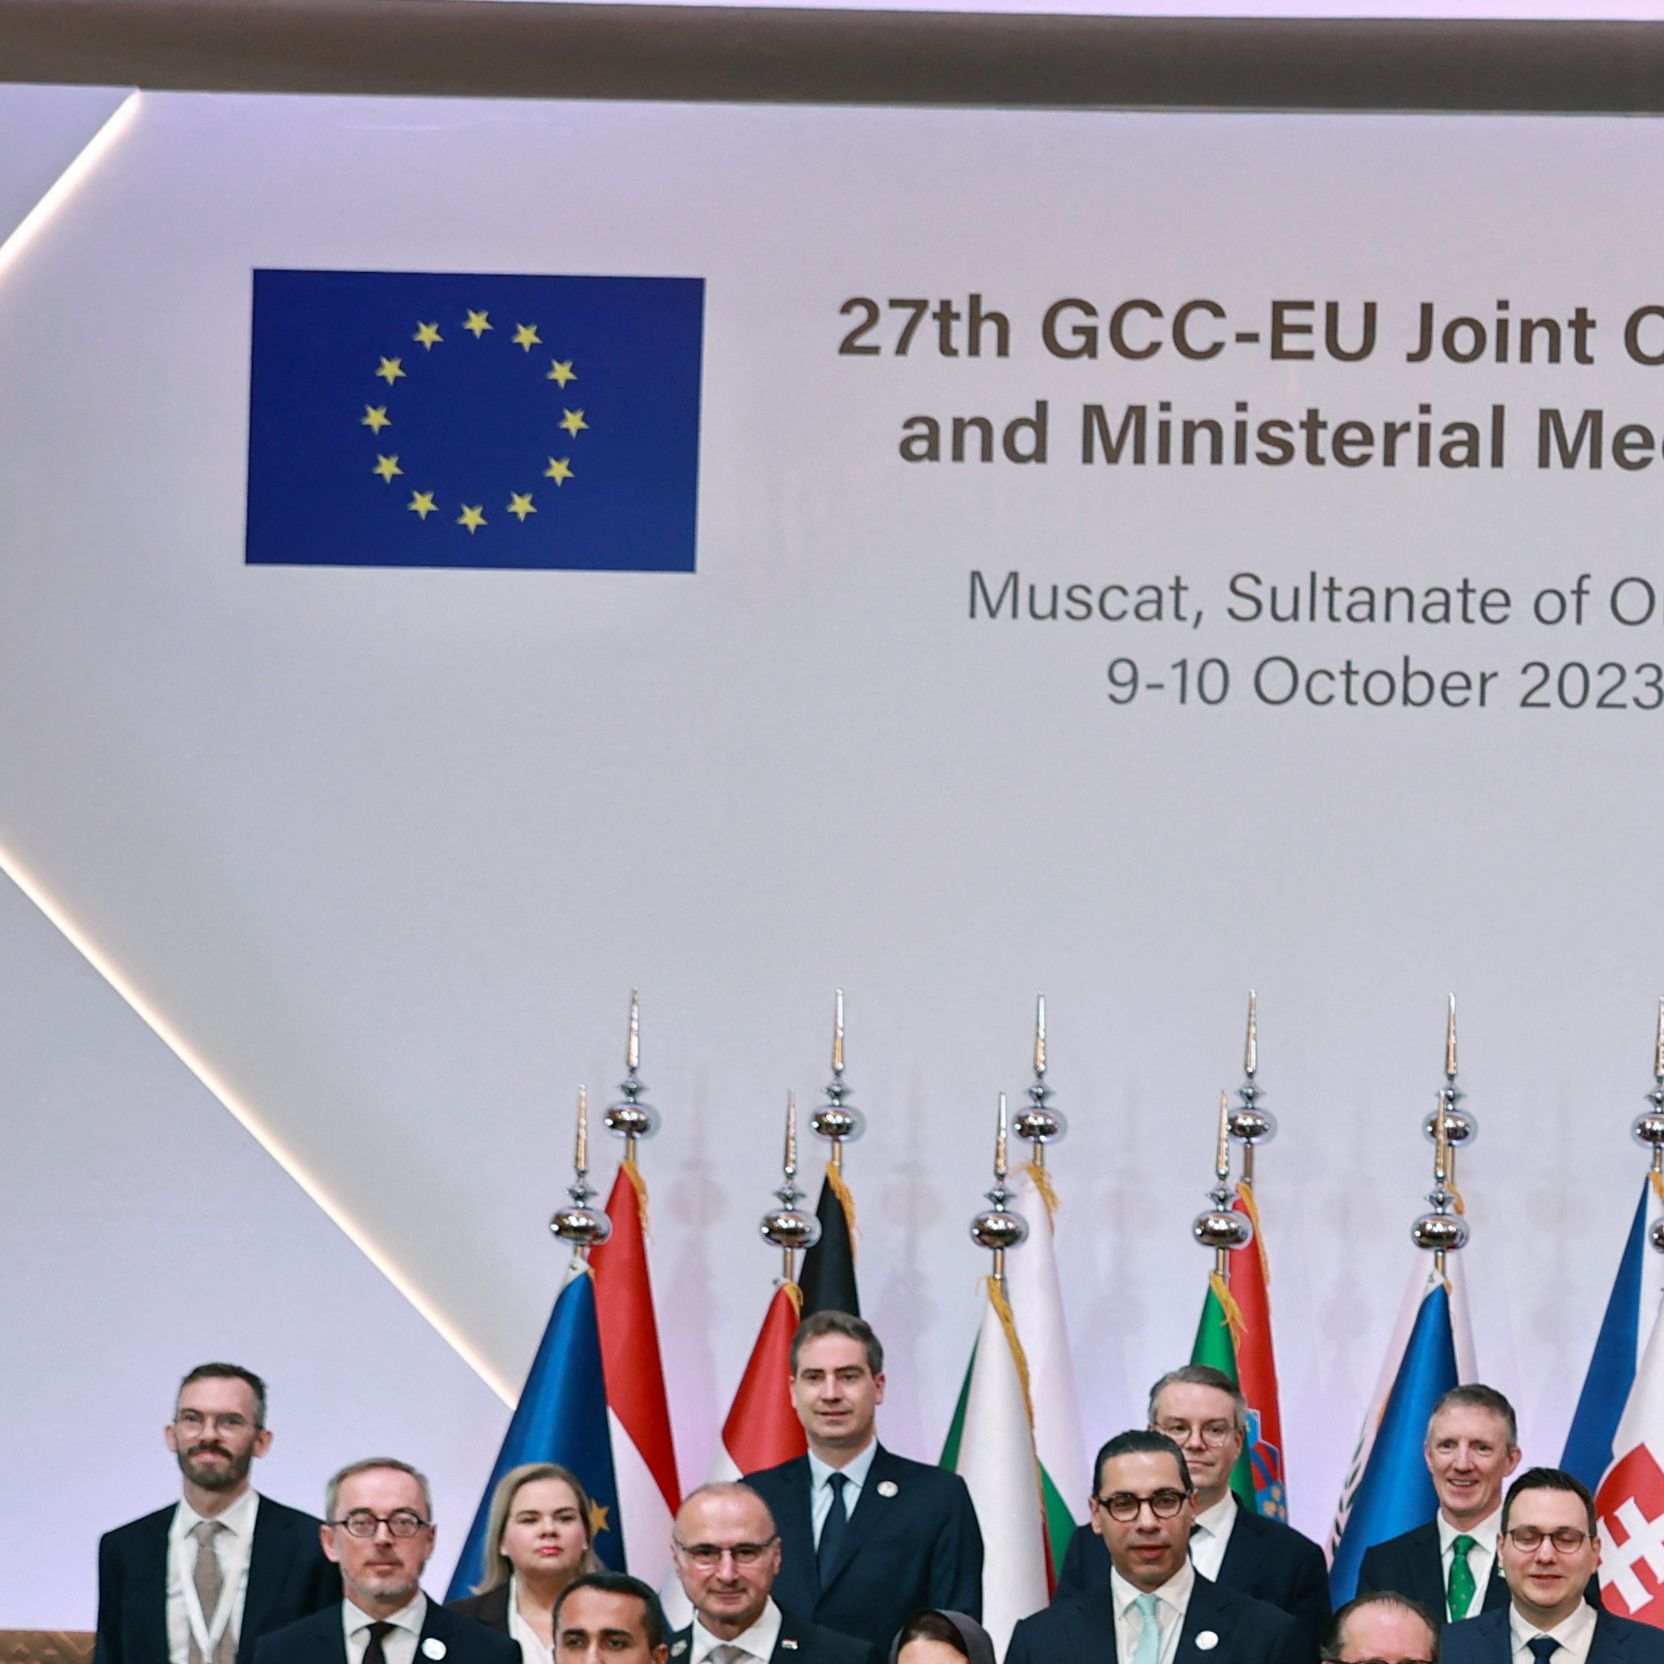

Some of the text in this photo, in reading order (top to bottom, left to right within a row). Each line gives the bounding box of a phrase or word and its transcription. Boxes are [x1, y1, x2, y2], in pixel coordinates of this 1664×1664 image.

[837, 293, 1010, 358] 27th
[1041, 297, 1378, 363] GCC-EU
[1405, 299, 1597, 365] Joint
[898, 399, 1049, 465] and
[1081, 400, 1505, 469] Ministerial
[969, 570, 1203, 630] Muscat,
[1226, 570, 1512, 625] Sultanate
[1533, 573, 1592, 626] of
[1107, 654, 1664, 711] 9-10 October 2023
